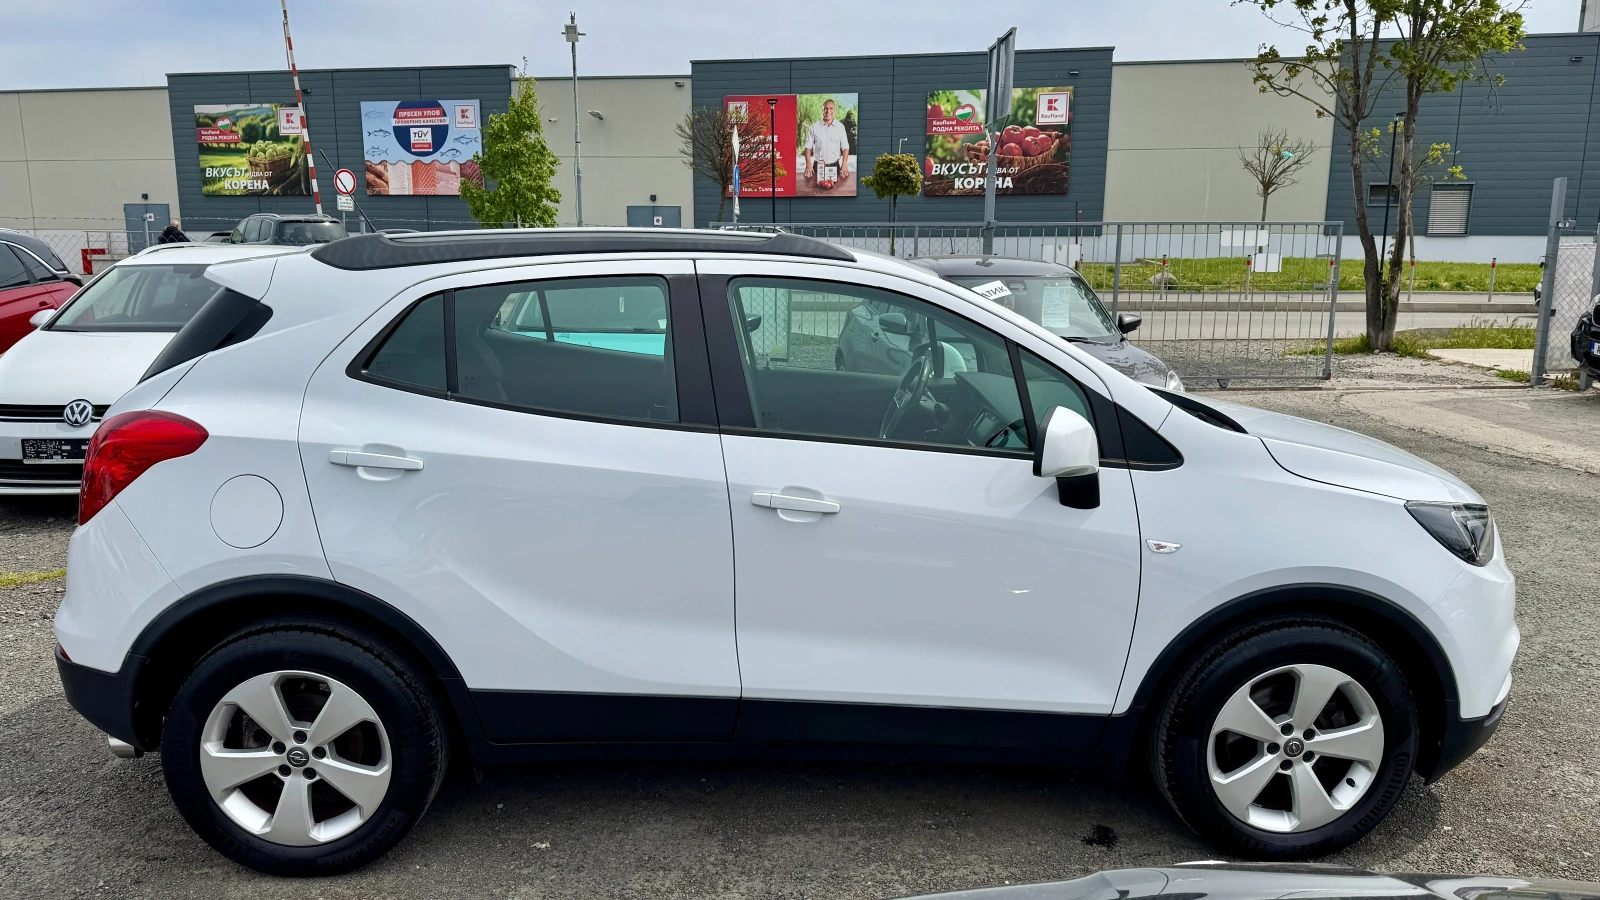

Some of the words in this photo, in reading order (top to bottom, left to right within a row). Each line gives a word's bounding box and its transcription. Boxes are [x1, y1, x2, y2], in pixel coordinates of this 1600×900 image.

[398, 110, 422, 118] ПРЕСЕН
[422, 109, 441, 117] УЛОВ
[412, 130, 430, 139] TÜV
[205, 166, 247, 178] ВКУСЪТ
[931, 162, 987, 176] ВКУСЪТ
[1008, 166, 1020, 174] ОТ
[224, 179, 270, 190] КОРЕНА
[954, 176, 1014, 189] КОРНА
[1352, 752, 1410, 833] Continental
